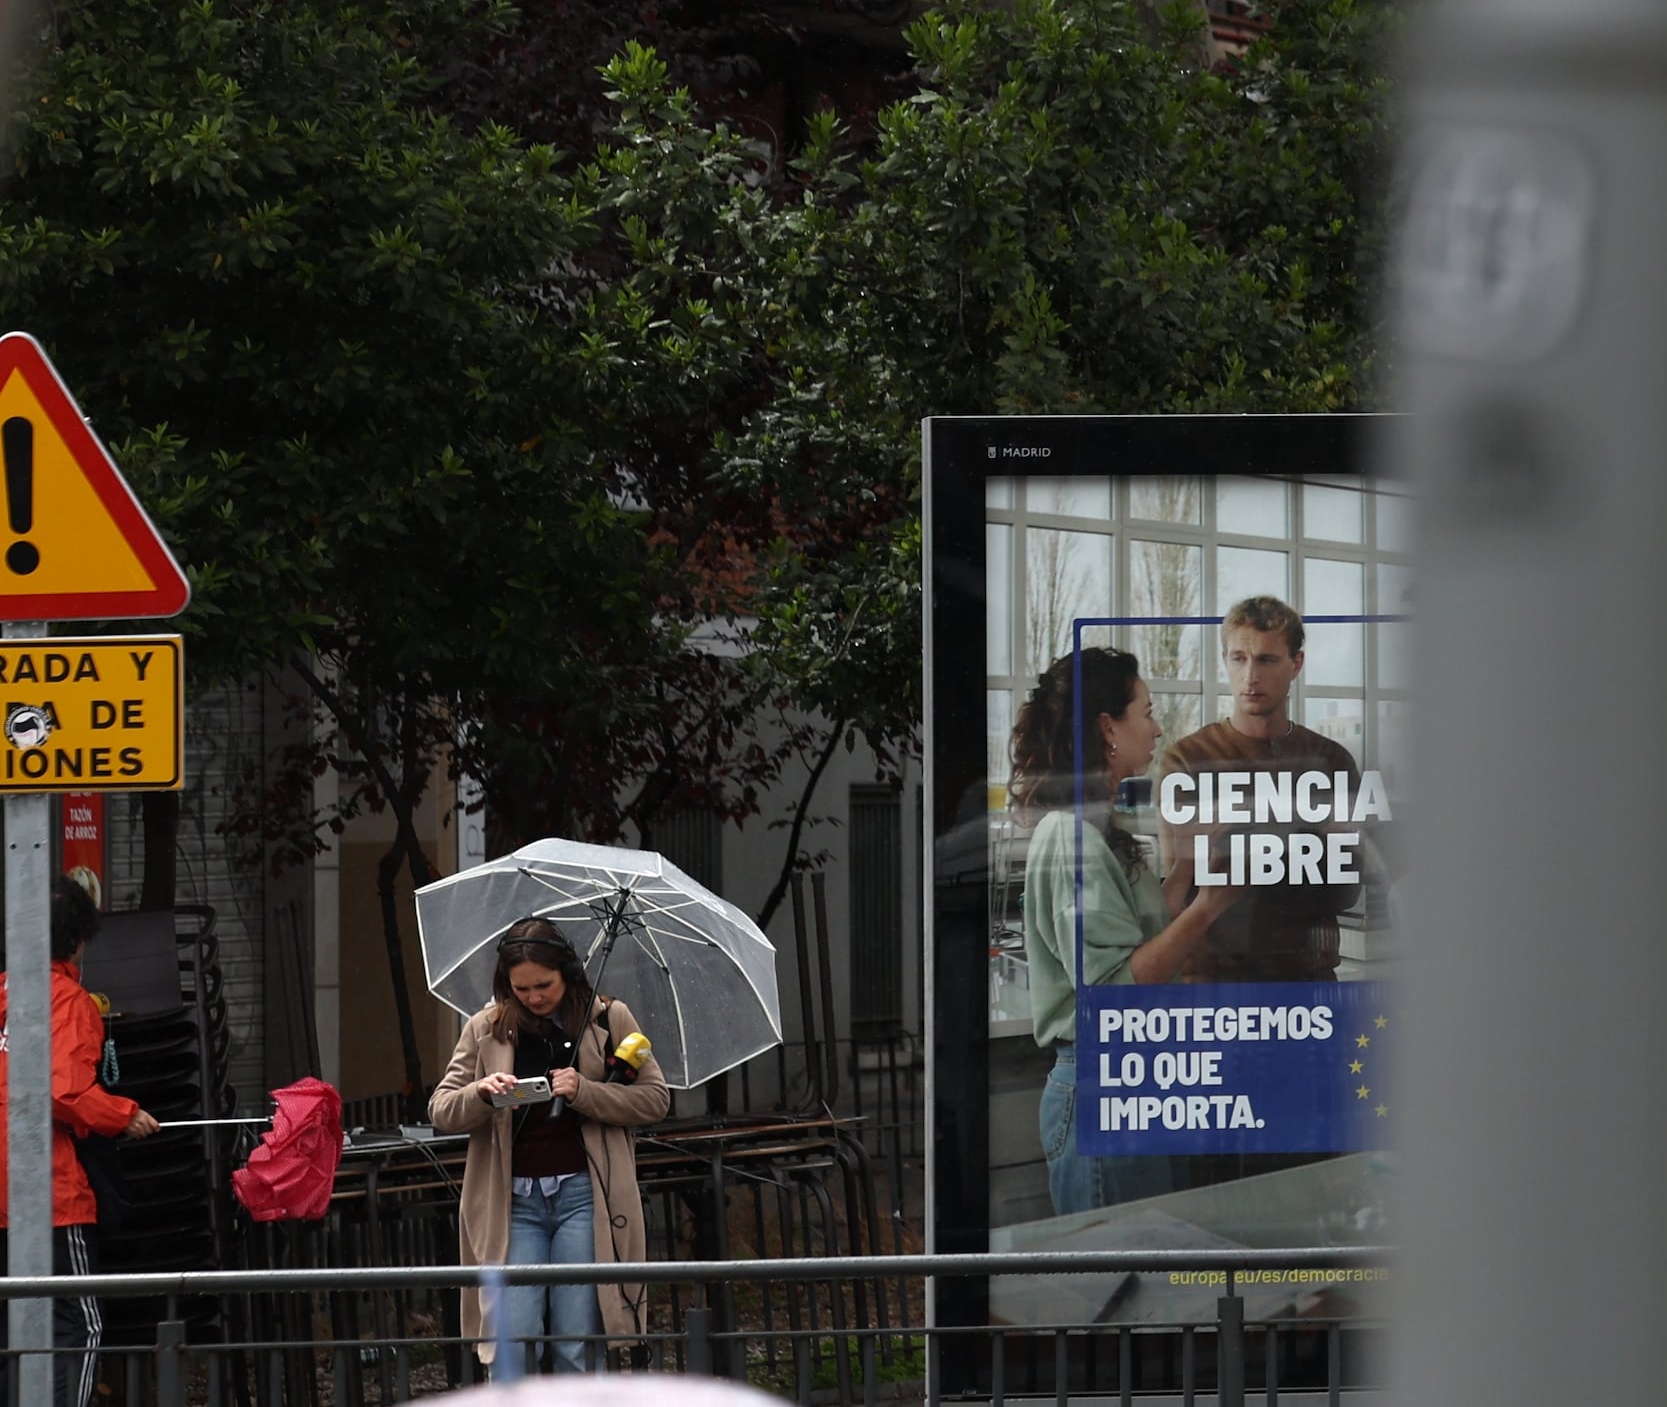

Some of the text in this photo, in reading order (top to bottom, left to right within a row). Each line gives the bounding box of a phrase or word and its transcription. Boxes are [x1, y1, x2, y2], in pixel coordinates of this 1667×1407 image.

[1002, 447, 1052, 458] MADRID
[129, 651, 154, 682] Y
[90, 699, 146, 730] DE
[6, 747, 143, 779] IONES
[1160, 770, 1393, 825] CIENCIA
[1194, 833, 1360, 887] LIBRE
[1099, 1006, 1334, 1043] PROTEGEMOS
[1099, 1051, 1223, 1090] LO QUE
[1099, 1095, 1266, 1131] IMPORTA.
